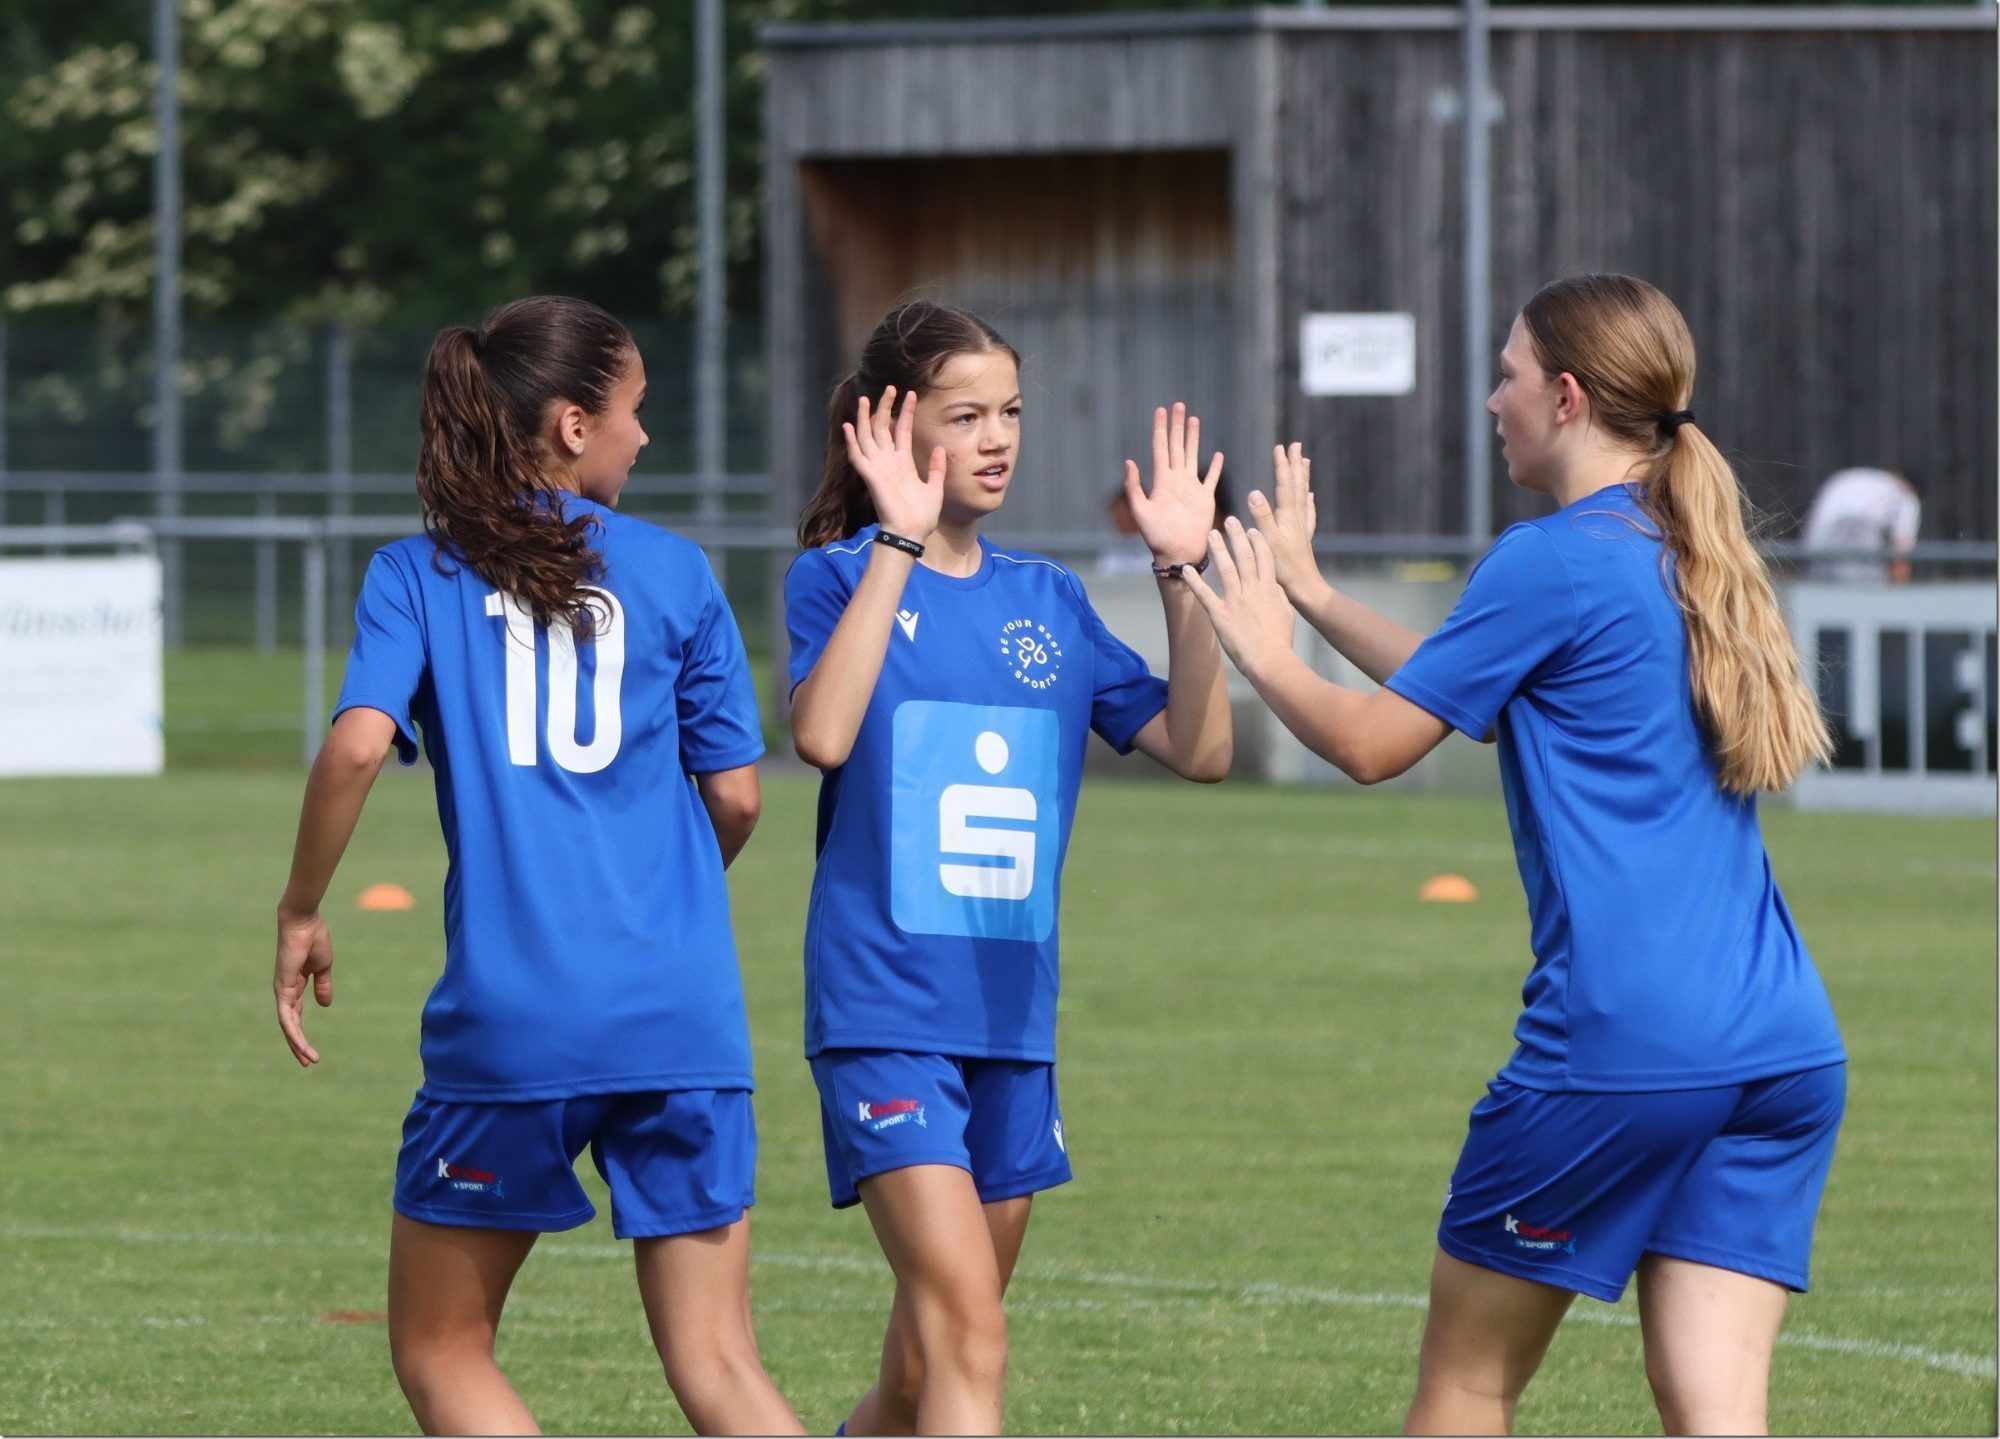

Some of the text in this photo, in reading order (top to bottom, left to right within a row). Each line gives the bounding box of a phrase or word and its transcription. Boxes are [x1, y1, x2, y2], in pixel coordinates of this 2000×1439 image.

[1000, 619, 1062, 657] BE YOUR BEST
[485, 585, 625, 774] 10
[1014, 670, 1057, 690] SPORTS
